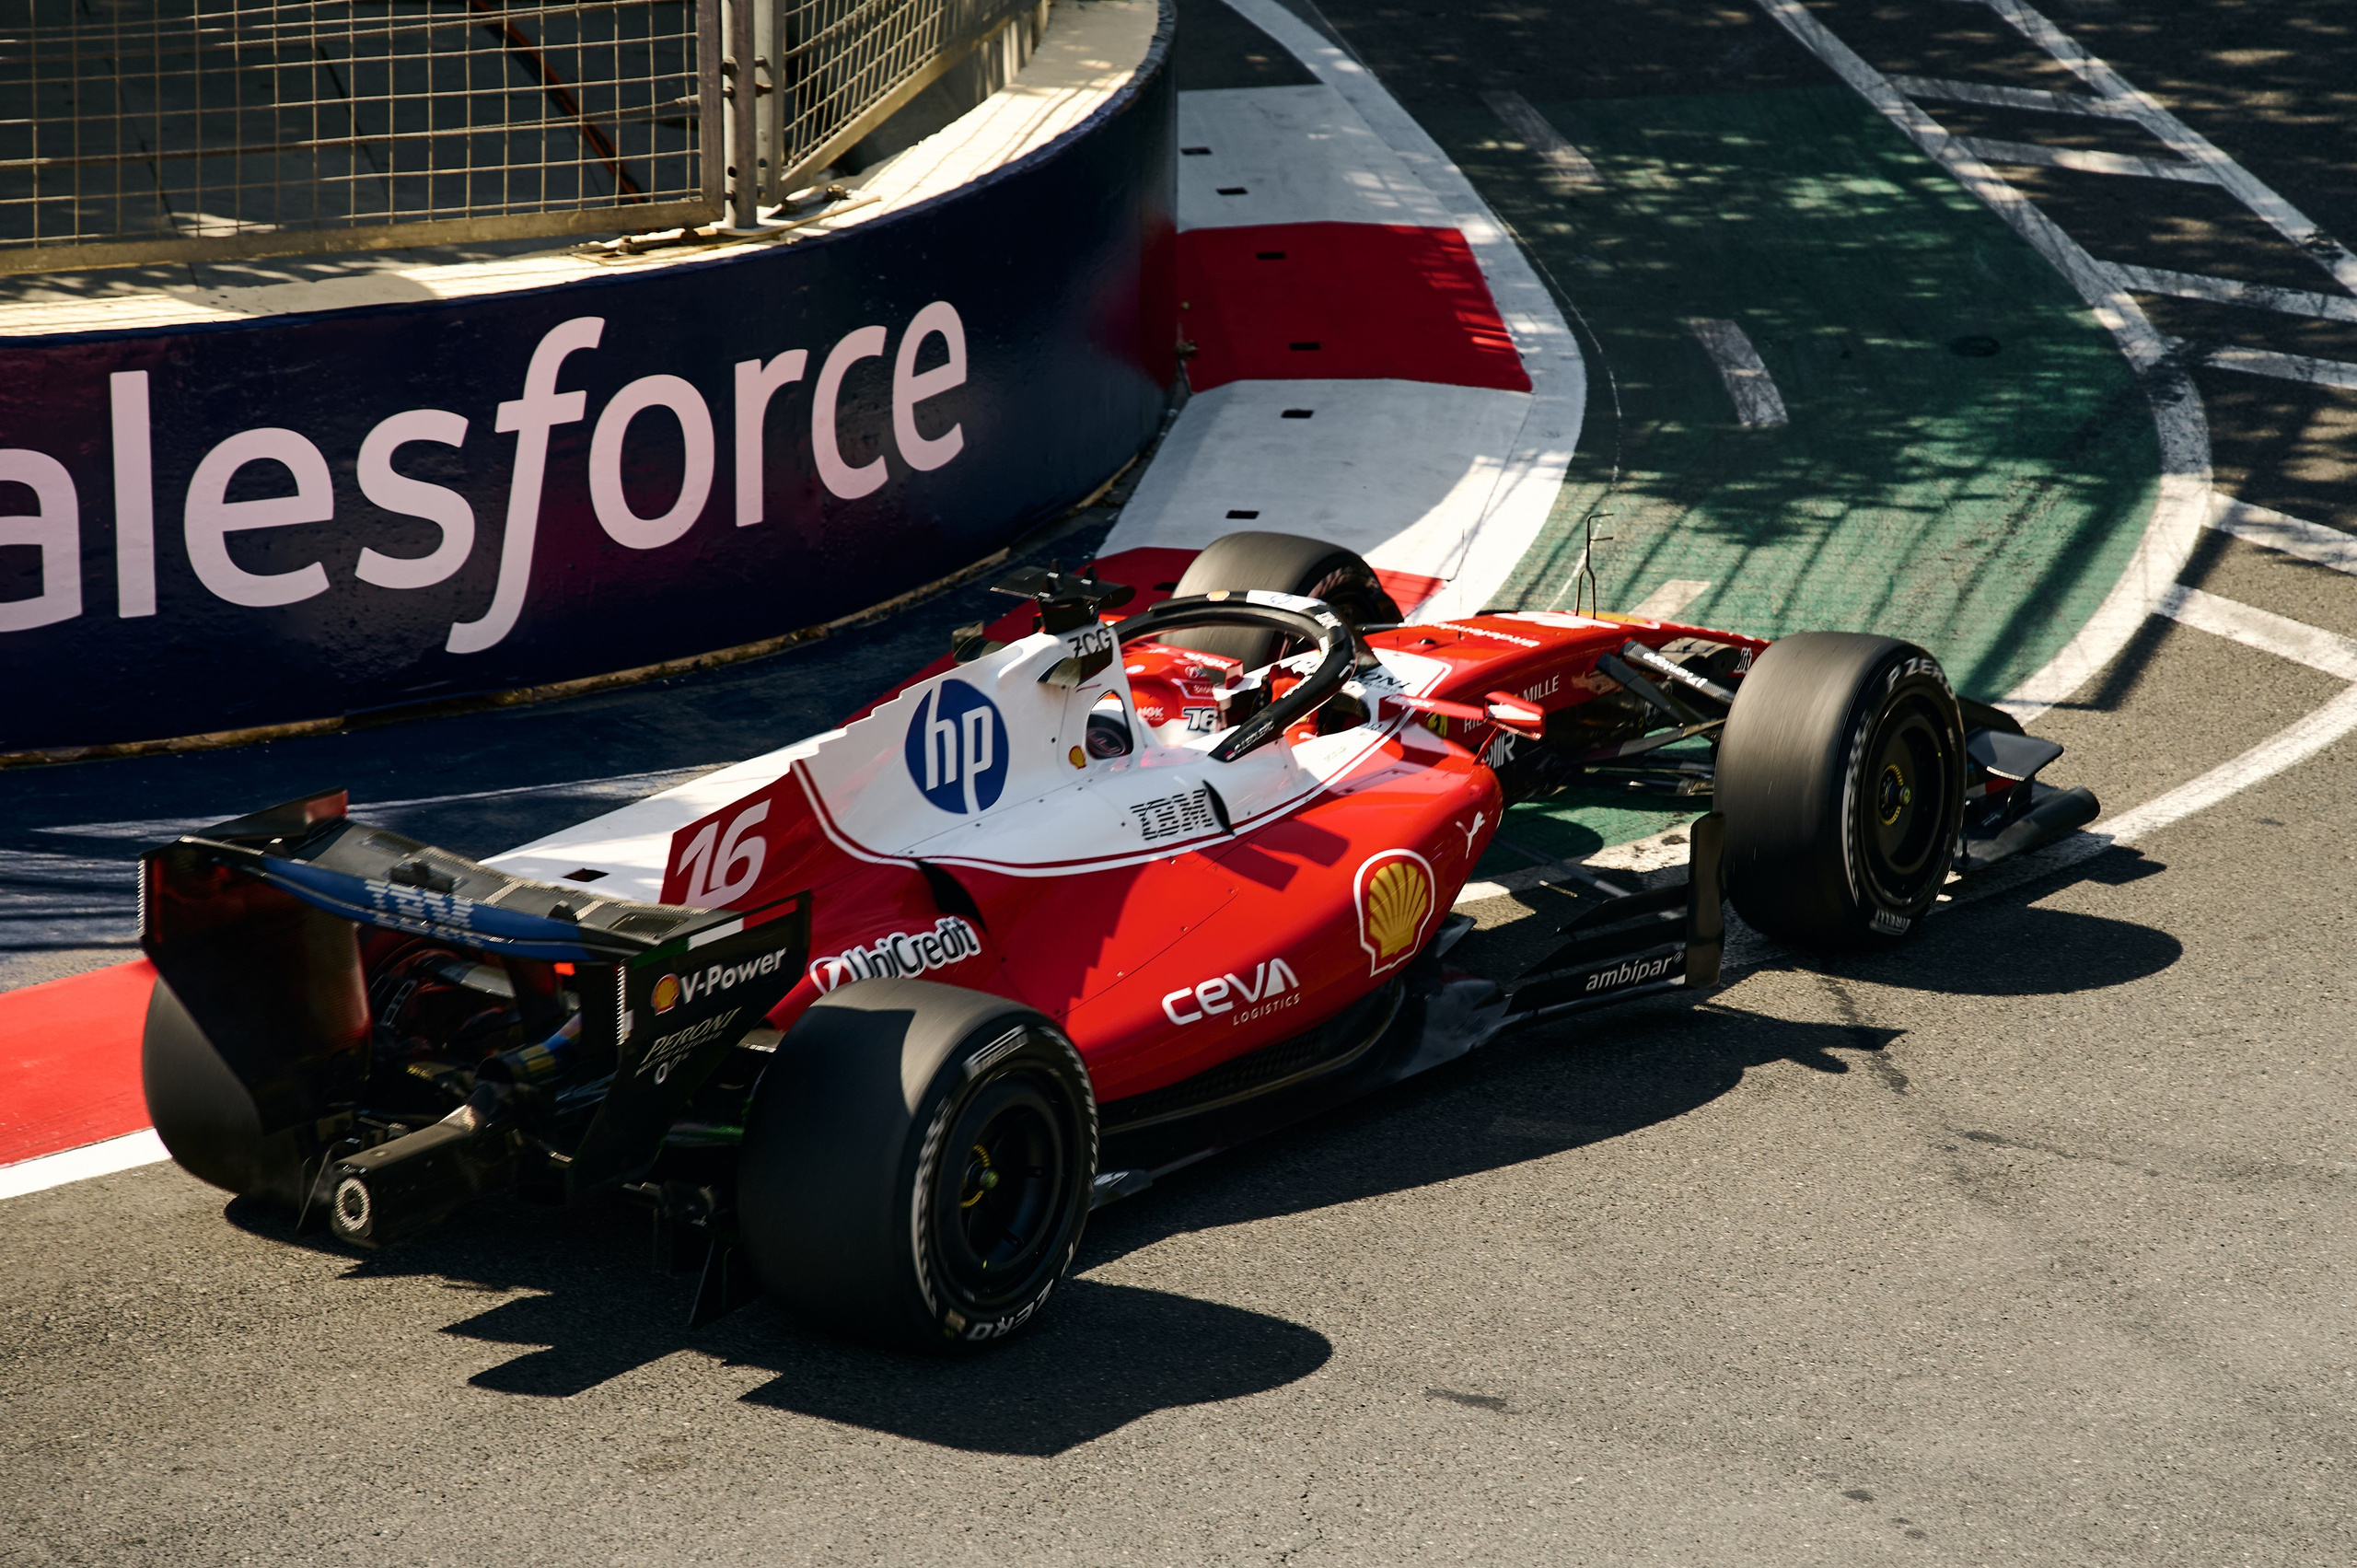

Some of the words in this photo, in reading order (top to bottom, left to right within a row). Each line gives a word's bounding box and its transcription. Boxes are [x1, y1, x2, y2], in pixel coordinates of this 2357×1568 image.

[924, 679, 993, 814] hp
[1129, 788, 1215, 841] IBM
[676, 798, 772, 912] 16
[680, 947, 788, 1005] V-Power
[844, 916, 981, 980] UniCredit
[640, 1006, 743, 1065] PERONI
[1232, 993, 1301, 1027] LOGISTICS
[967, 1277, 1054, 1341] ZERO
